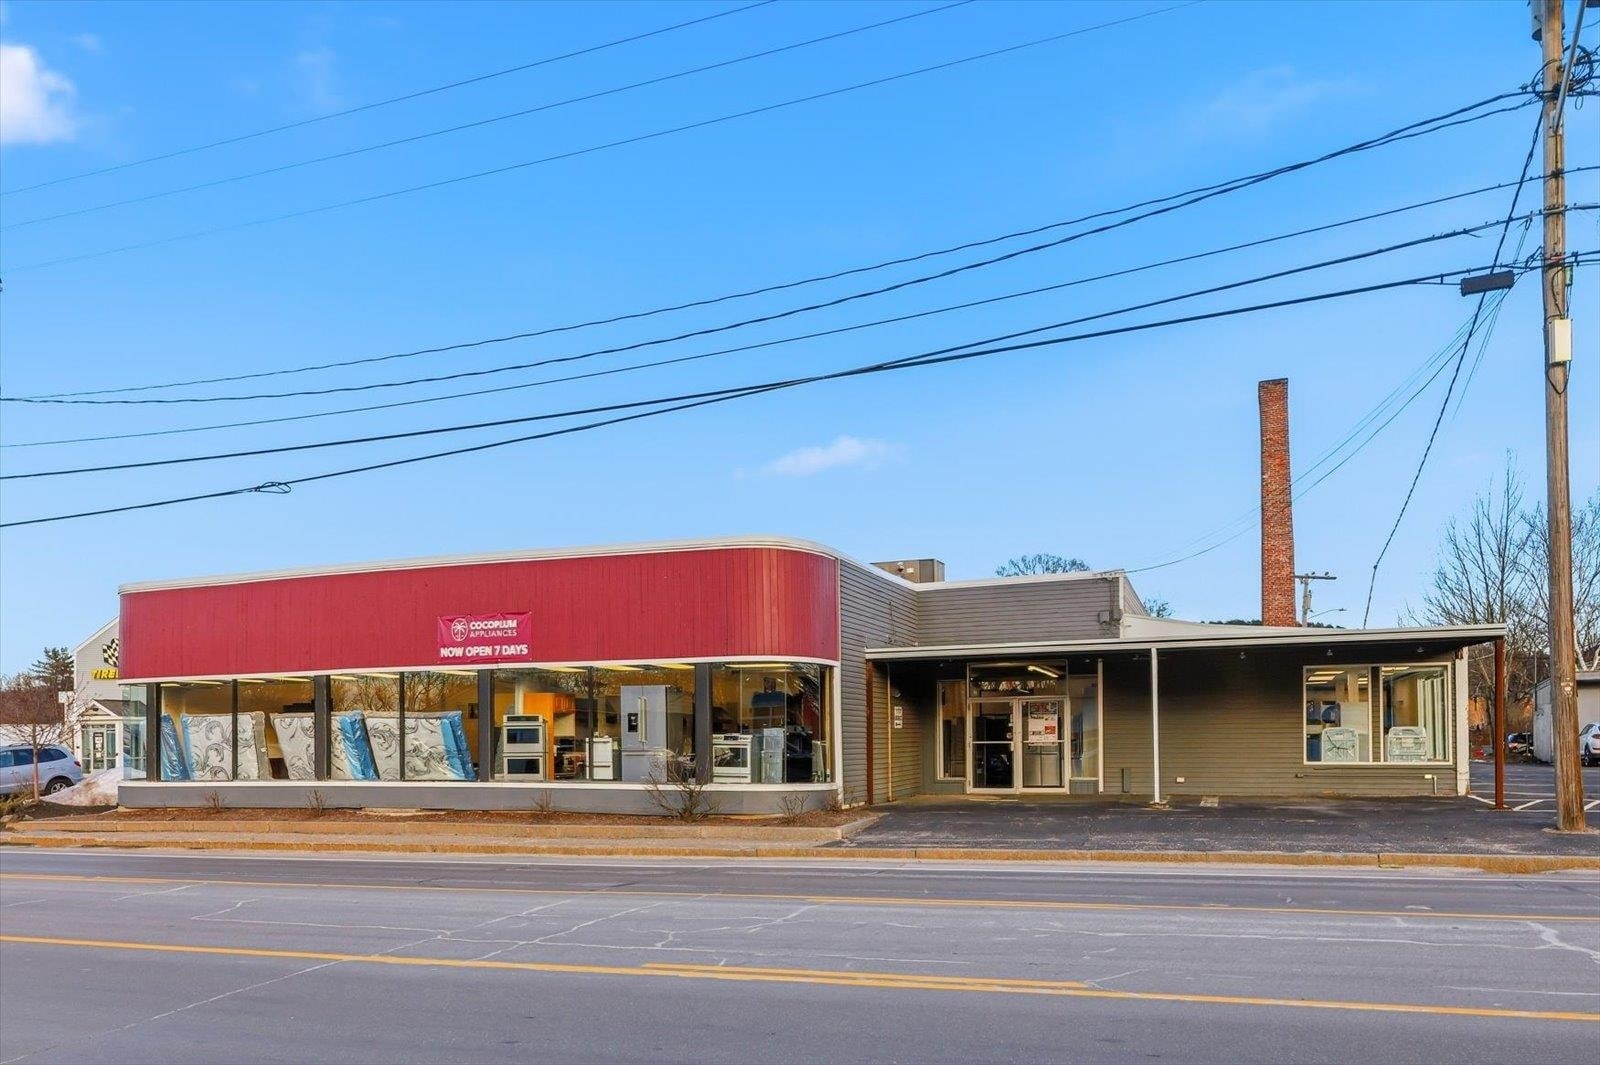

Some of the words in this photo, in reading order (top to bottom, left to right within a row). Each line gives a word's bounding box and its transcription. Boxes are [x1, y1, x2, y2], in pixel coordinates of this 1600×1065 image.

[469, 619, 517, 629] COCOPLUM
[469, 629, 517, 637] APPLIANCES
[440, 646, 464, 657] NOW
[465, 645, 493, 657] OPEN
[494, 645, 501, 655] 7
[501, 644, 528, 655] DAYS
[91, 668, 119, 680] TIRE
